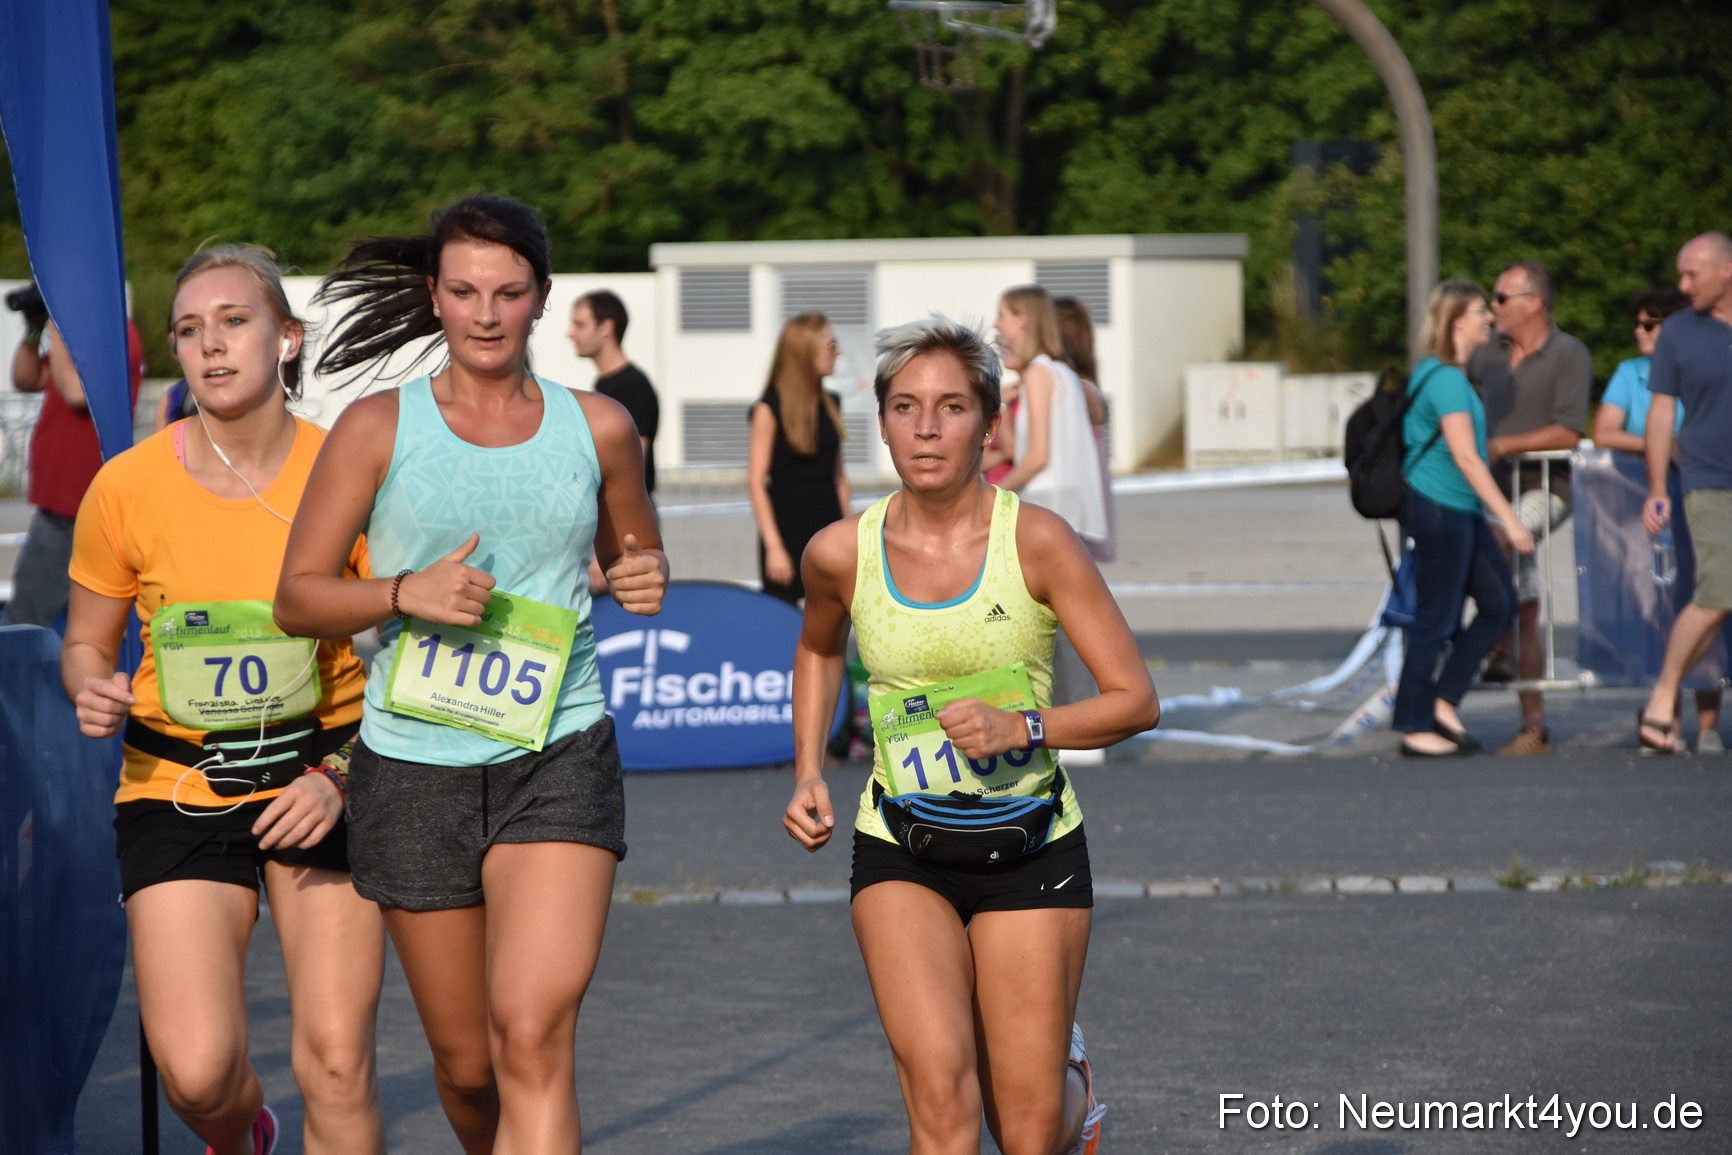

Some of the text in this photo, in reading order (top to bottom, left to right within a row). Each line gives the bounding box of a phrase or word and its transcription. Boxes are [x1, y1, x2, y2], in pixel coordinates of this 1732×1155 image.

[984, 615, 1011, 623] adidas
[176, 624, 231, 635] firmenlauf
[233, 629, 262, 638] 2015
[491, 620, 522, 636] 2015
[204, 655, 268, 697] 70
[418, 633, 546, 705] 1105
[611, 661, 794, 709] Fische
[430, 692, 506, 719] Alexandra Hiller
[976, 780, 1020, 796] Scherzer
